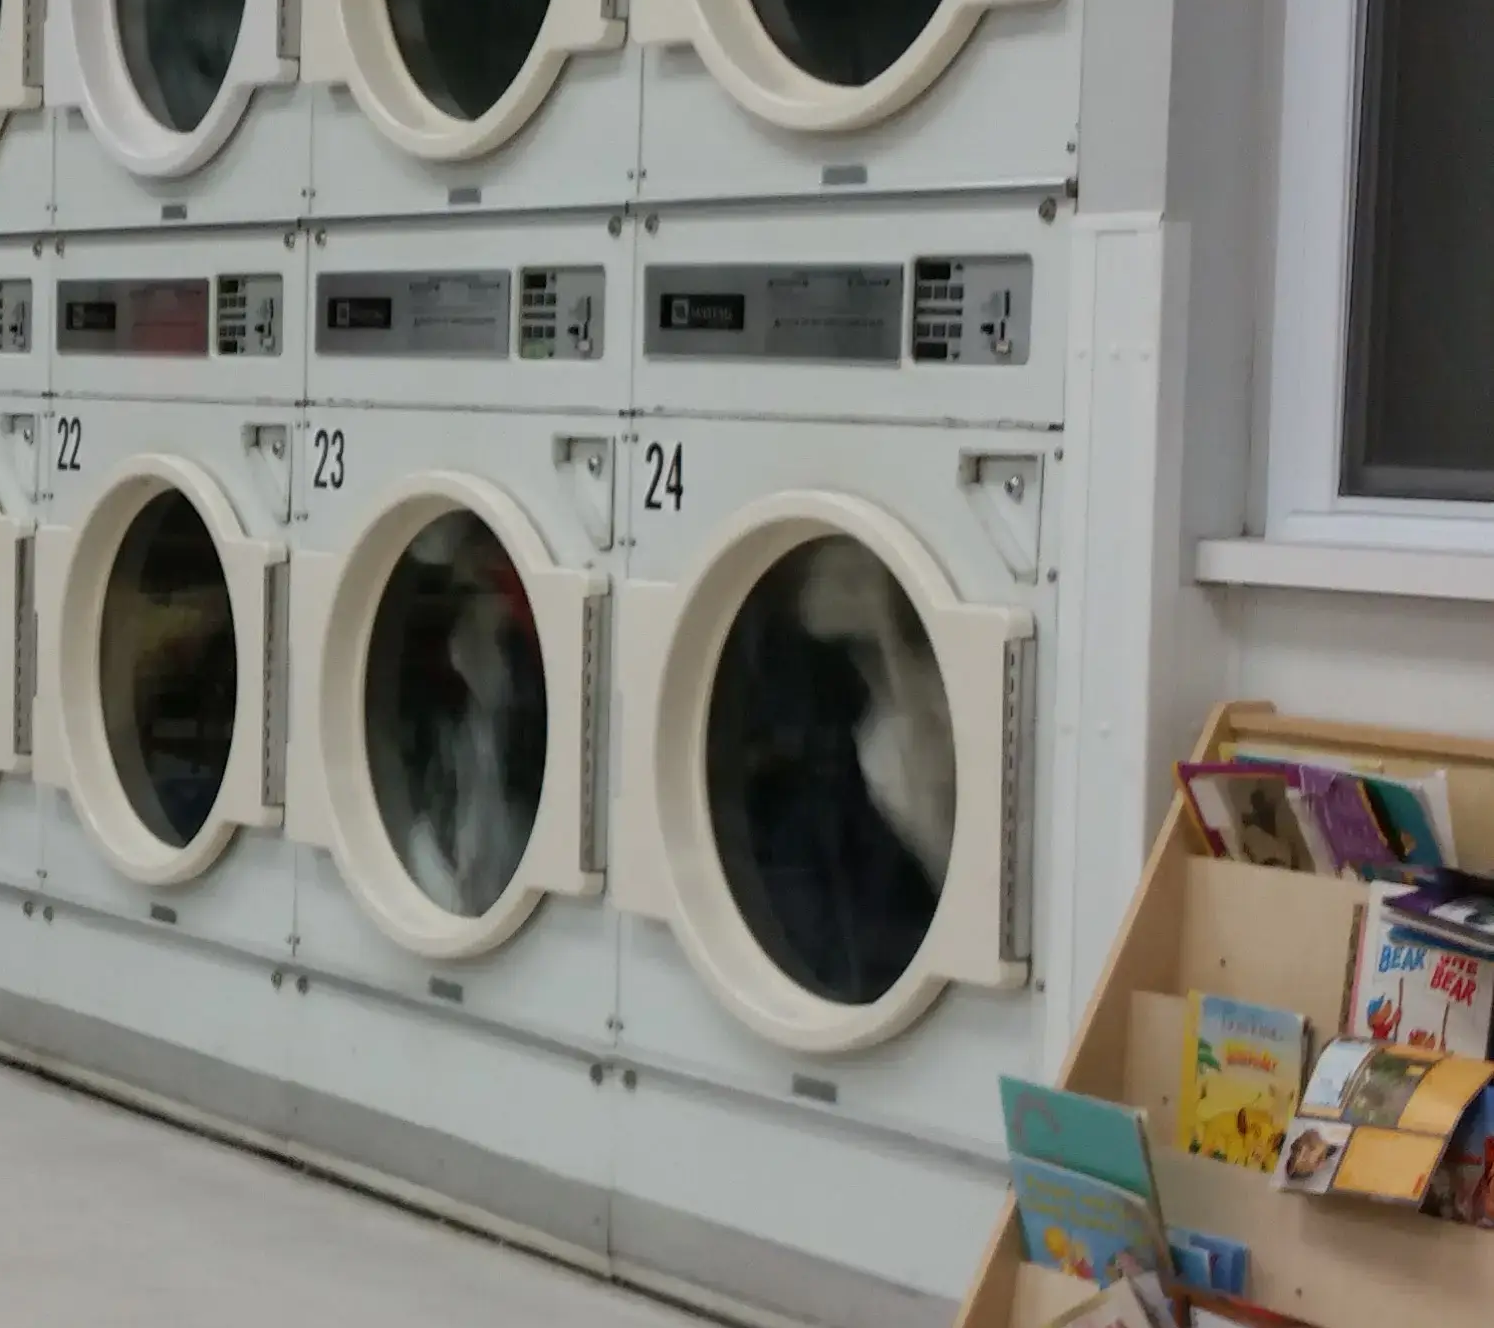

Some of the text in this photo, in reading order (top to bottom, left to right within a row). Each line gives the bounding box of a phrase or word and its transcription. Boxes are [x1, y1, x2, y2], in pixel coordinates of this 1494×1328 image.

[57, 417, 81, 471] 22
[313, 429, 344, 489] 23
[645, 441, 683, 511] 24
[1430, 966, 1477, 1007] BEAR
